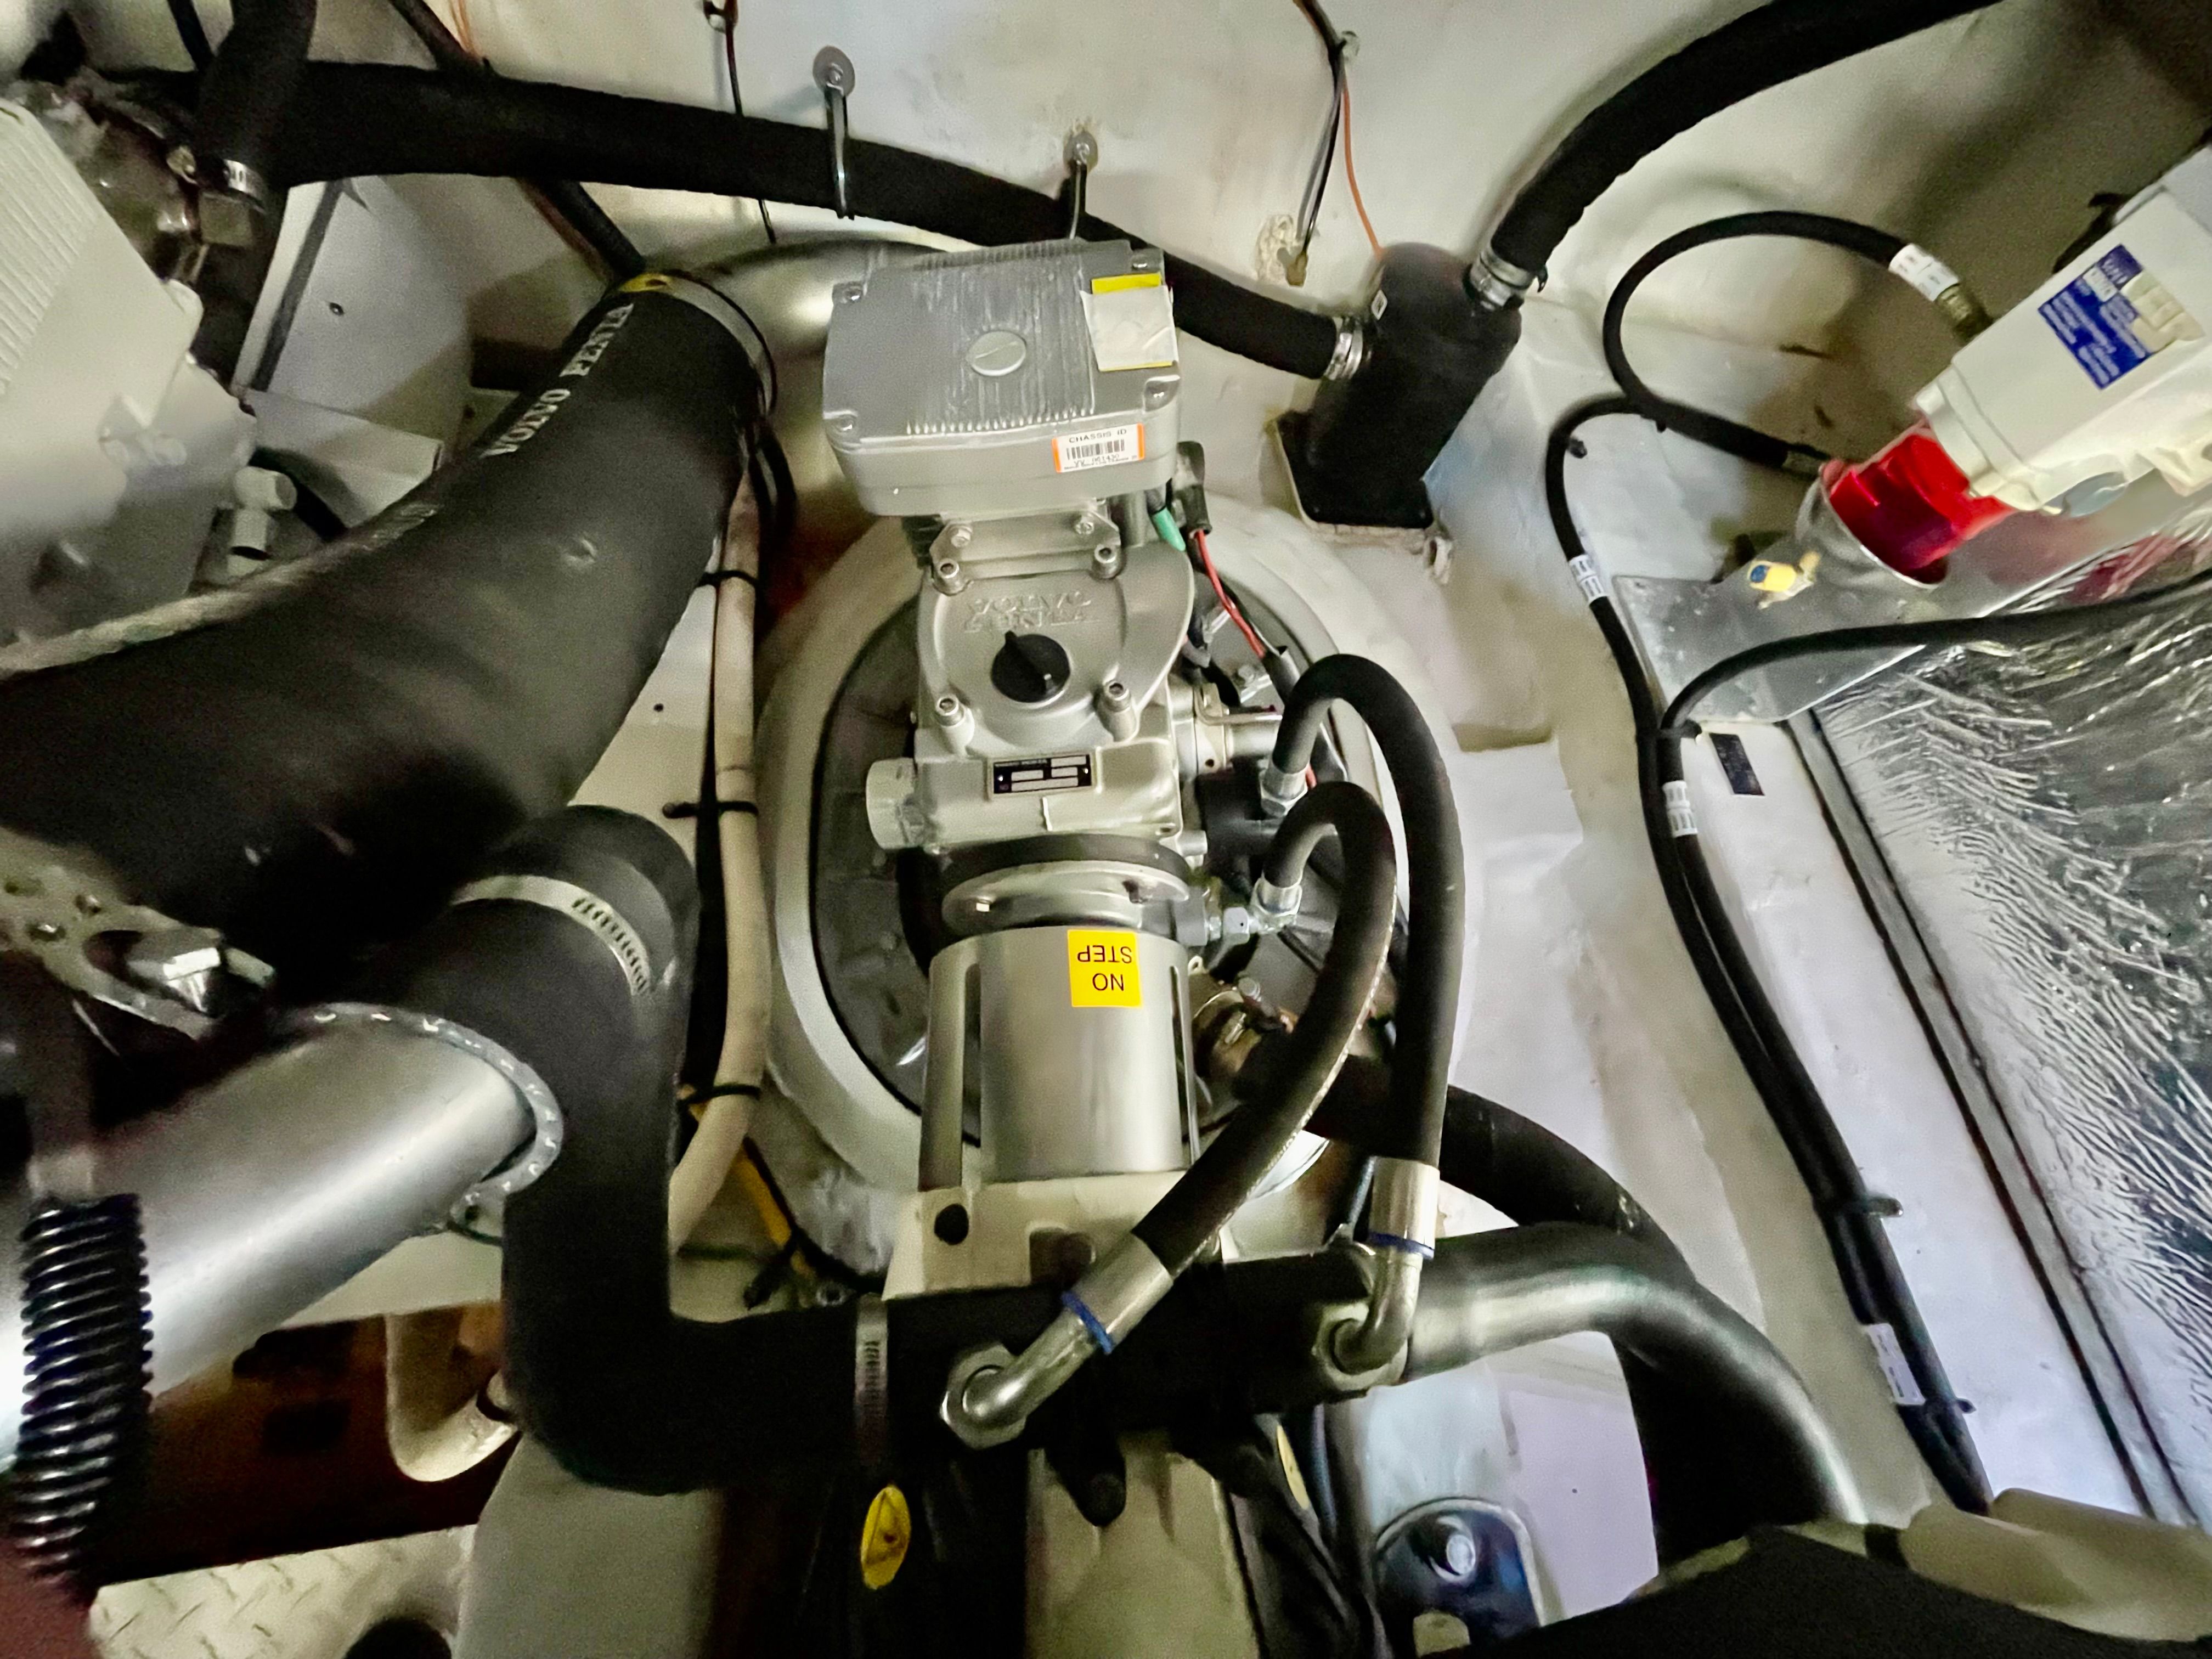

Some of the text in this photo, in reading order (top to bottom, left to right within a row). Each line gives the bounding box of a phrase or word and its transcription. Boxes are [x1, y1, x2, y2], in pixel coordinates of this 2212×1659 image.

[478, 303, 634, 459] VOLVO PENTA
[1069, 431, 1111, 443] CHASSIS
[1077, 945, 1132, 964] STEP
[1092, 973, 1124, 991] NO
